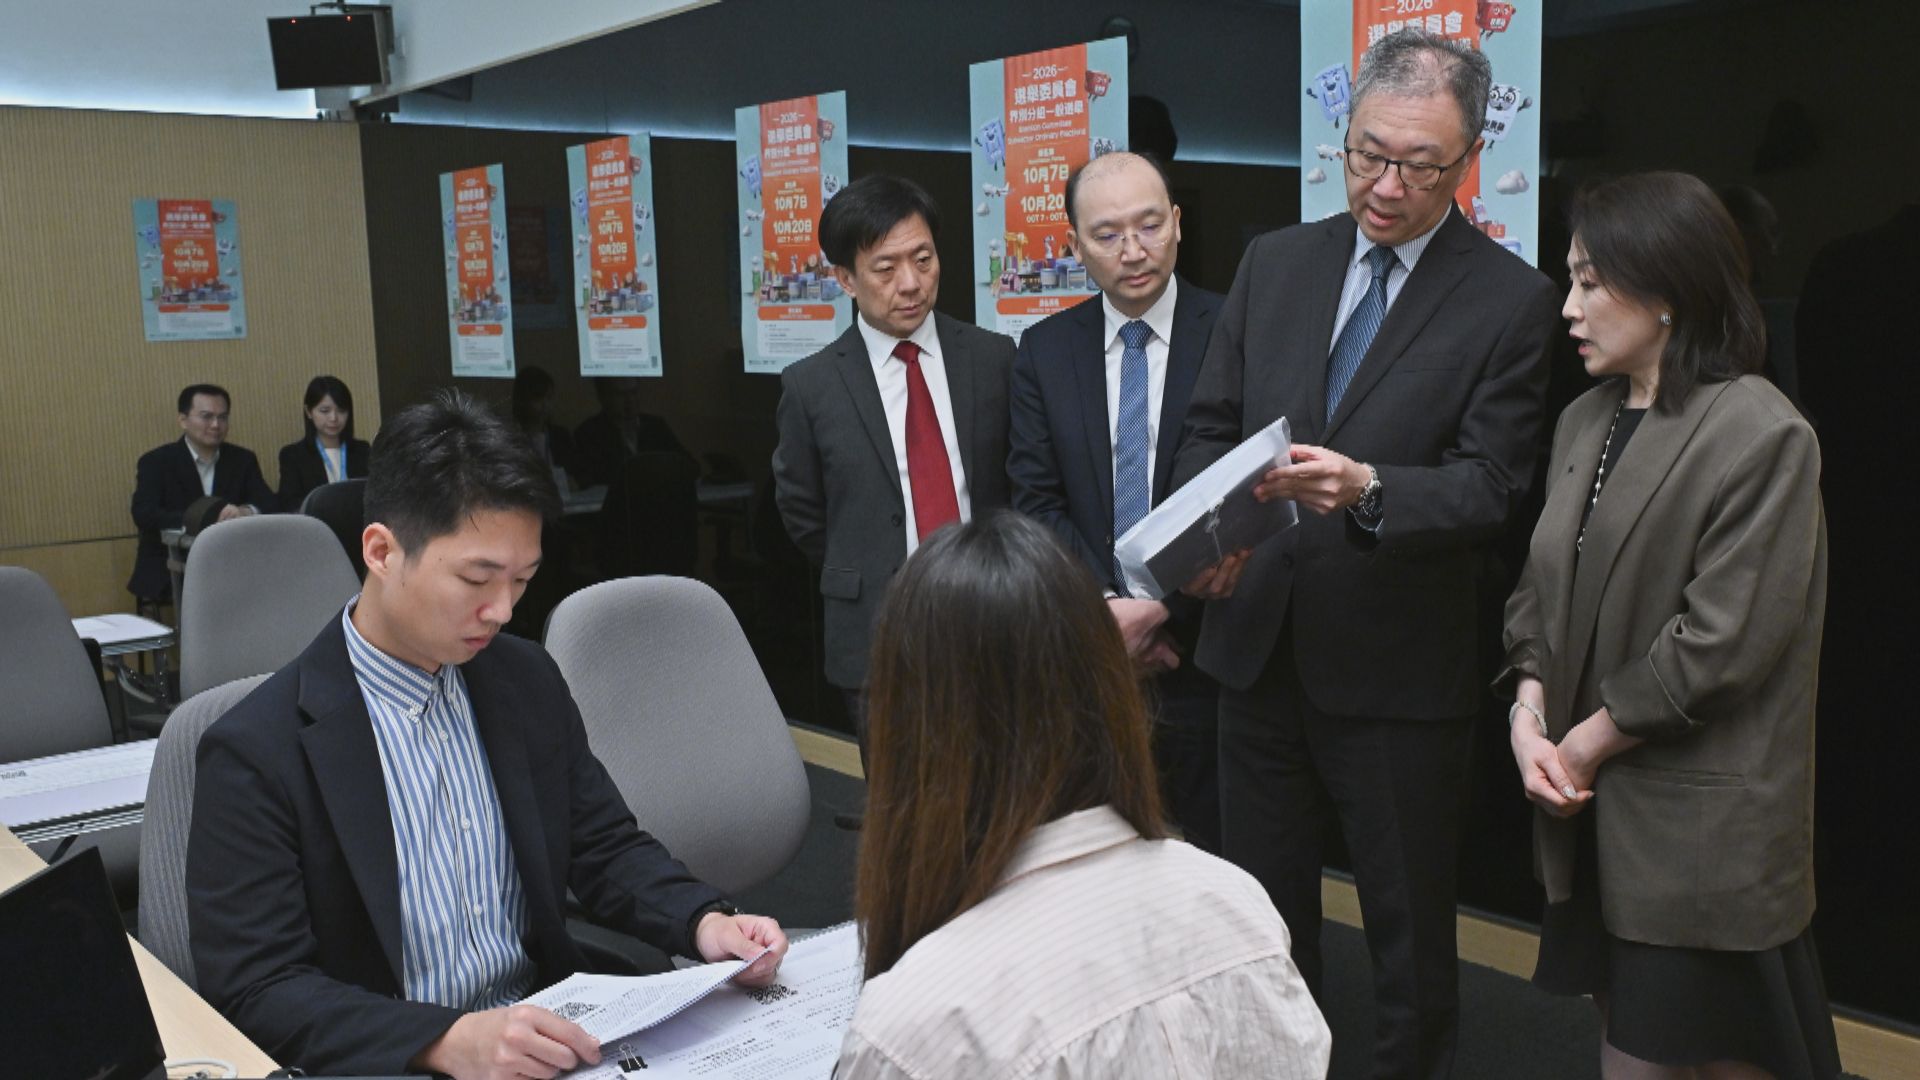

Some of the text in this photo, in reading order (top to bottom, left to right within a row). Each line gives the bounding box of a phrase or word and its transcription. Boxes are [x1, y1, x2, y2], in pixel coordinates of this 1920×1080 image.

[1033, 64, 1057, 79] 2026
[1023, 164, 1069, 184] 10月7日
[774, 194, 807, 211] 10月7日
[1020, 193, 1066, 213] 10月20
[773, 218, 812, 236] 10月20日
